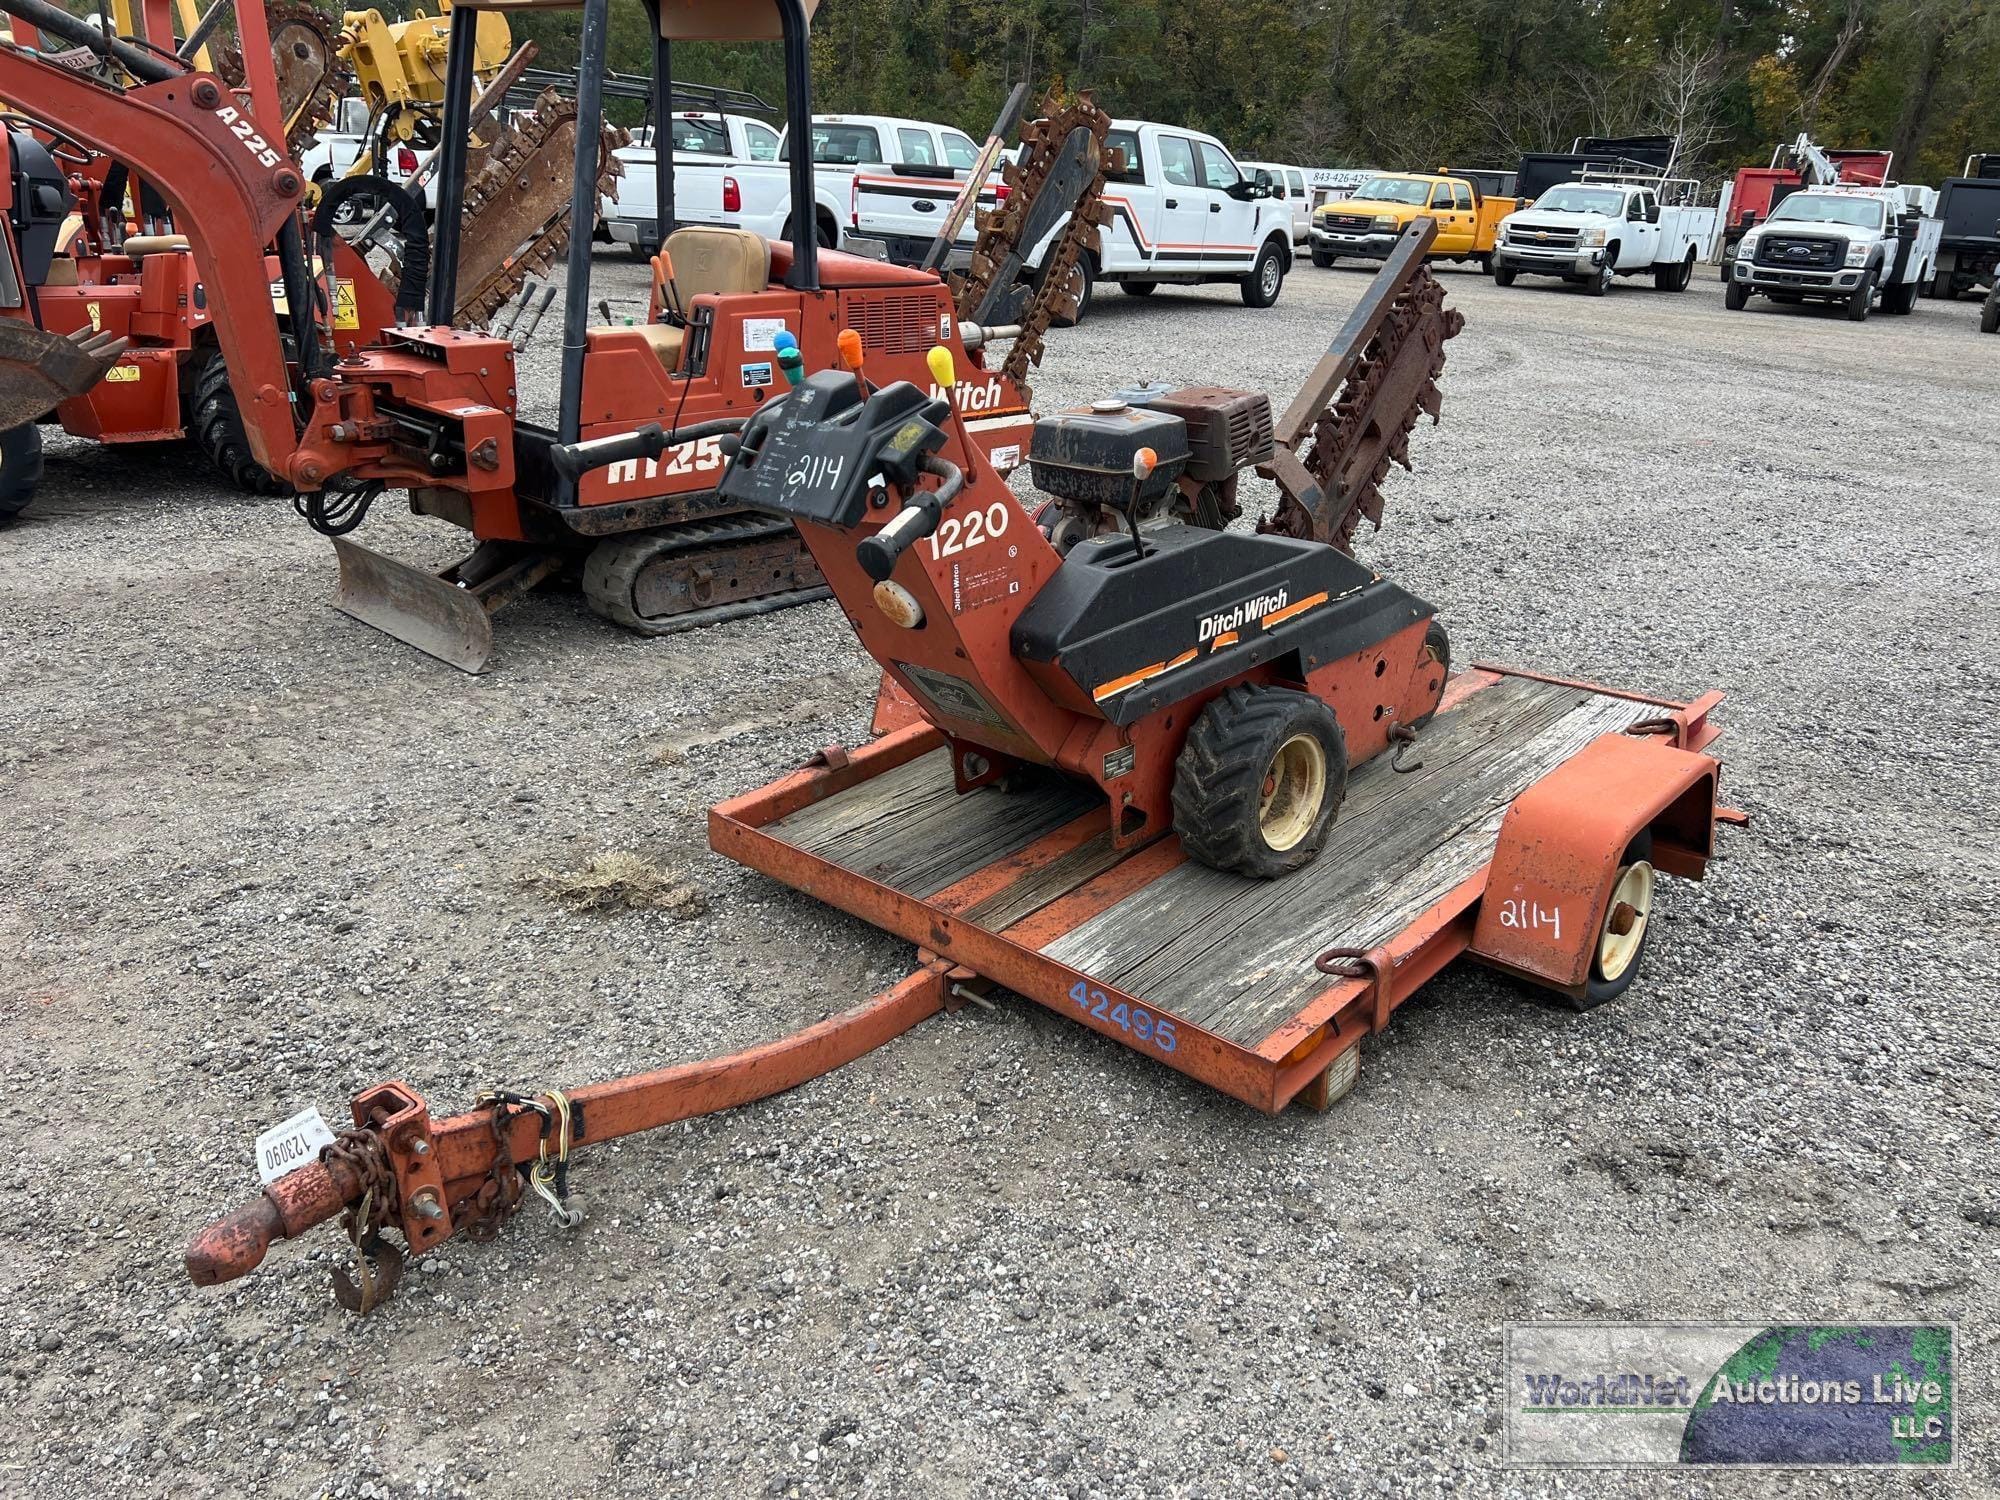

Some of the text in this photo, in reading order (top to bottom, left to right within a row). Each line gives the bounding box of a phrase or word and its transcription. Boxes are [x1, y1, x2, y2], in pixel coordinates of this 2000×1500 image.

[215, 106, 282, 168] A225
[1313, 171, 1373, 184] 843-426-425
[787, 454, 844, 490] 2114
[923, 502, 1009, 560] 1220
[1199, 588, 1288, 642] Ditch Witch
[1500, 899, 1560, 939] 2114
[1069, 981, 1176, 1052] 42495
[265, 1133, 311, 1170] 123090
